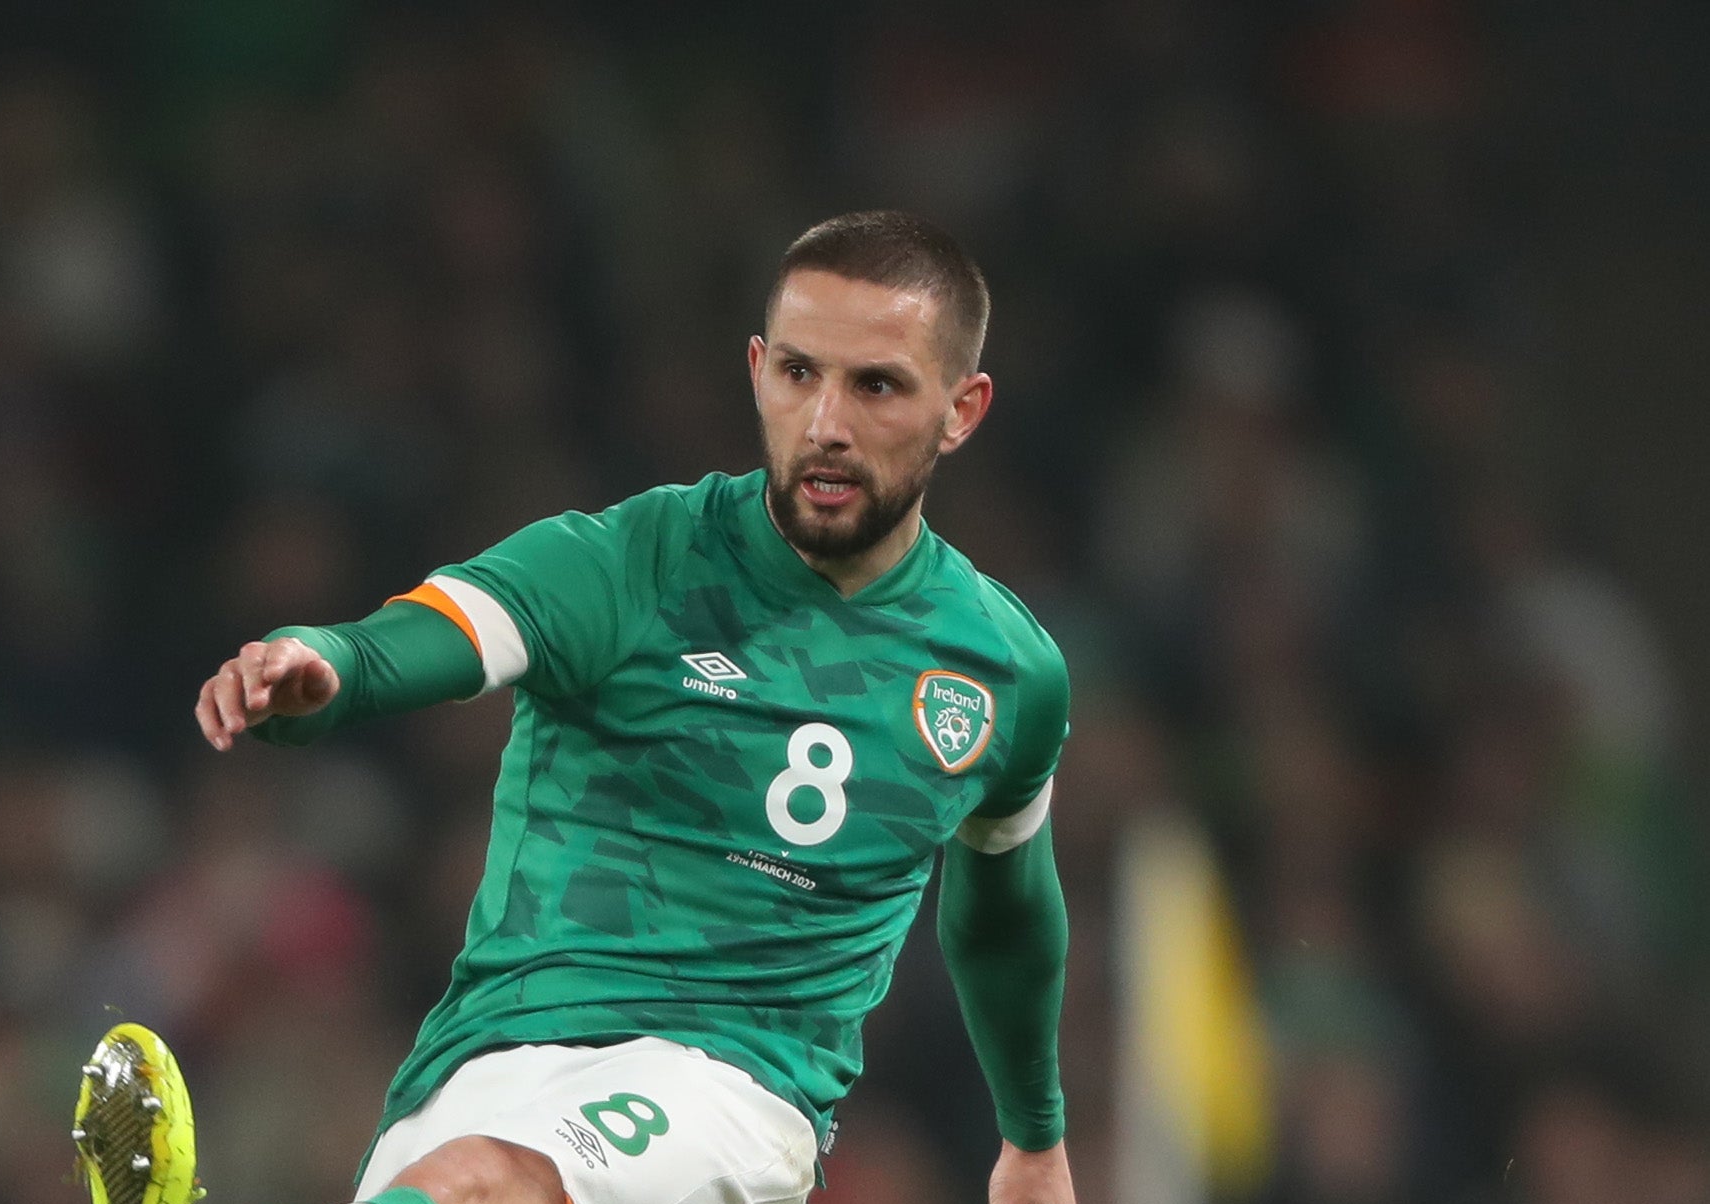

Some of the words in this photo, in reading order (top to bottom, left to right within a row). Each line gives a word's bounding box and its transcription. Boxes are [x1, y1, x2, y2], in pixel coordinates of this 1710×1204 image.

[682, 676, 737, 700] umbro
[932, 680, 981, 711] Ireland
[765, 722, 853, 846] 8
[750, 860, 792, 882] MARCH
[791, 873, 816, 891] 2022
[579, 1092, 670, 1157] 8
[555, 1128, 595, 1170] umbro
